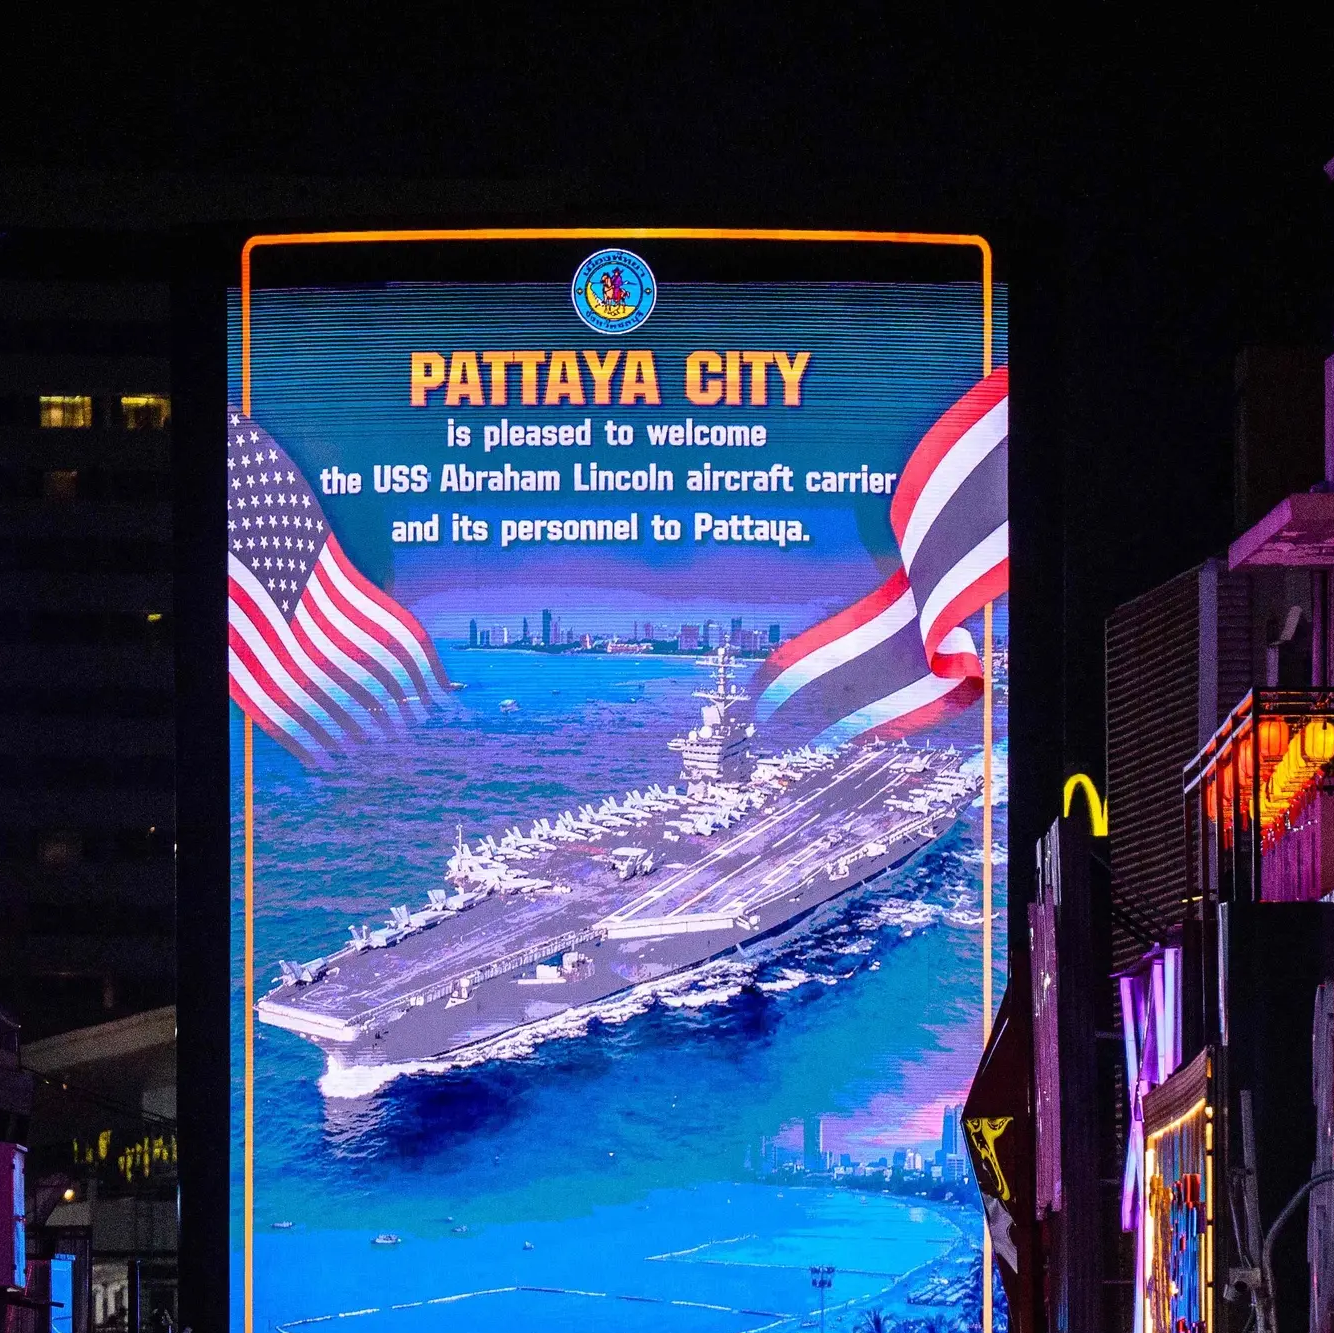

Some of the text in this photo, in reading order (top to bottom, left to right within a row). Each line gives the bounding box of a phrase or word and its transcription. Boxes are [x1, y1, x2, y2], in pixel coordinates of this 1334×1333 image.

[409, 350, 812, 407] PATTAYA CITY
[447, 419, 767, 452] is pleased to welcome
[320, 465, 896, 494] the USS Abraham Lincoln aircraft carrier
[391, 513, 810, 547] and its personnel to Pattaya.
